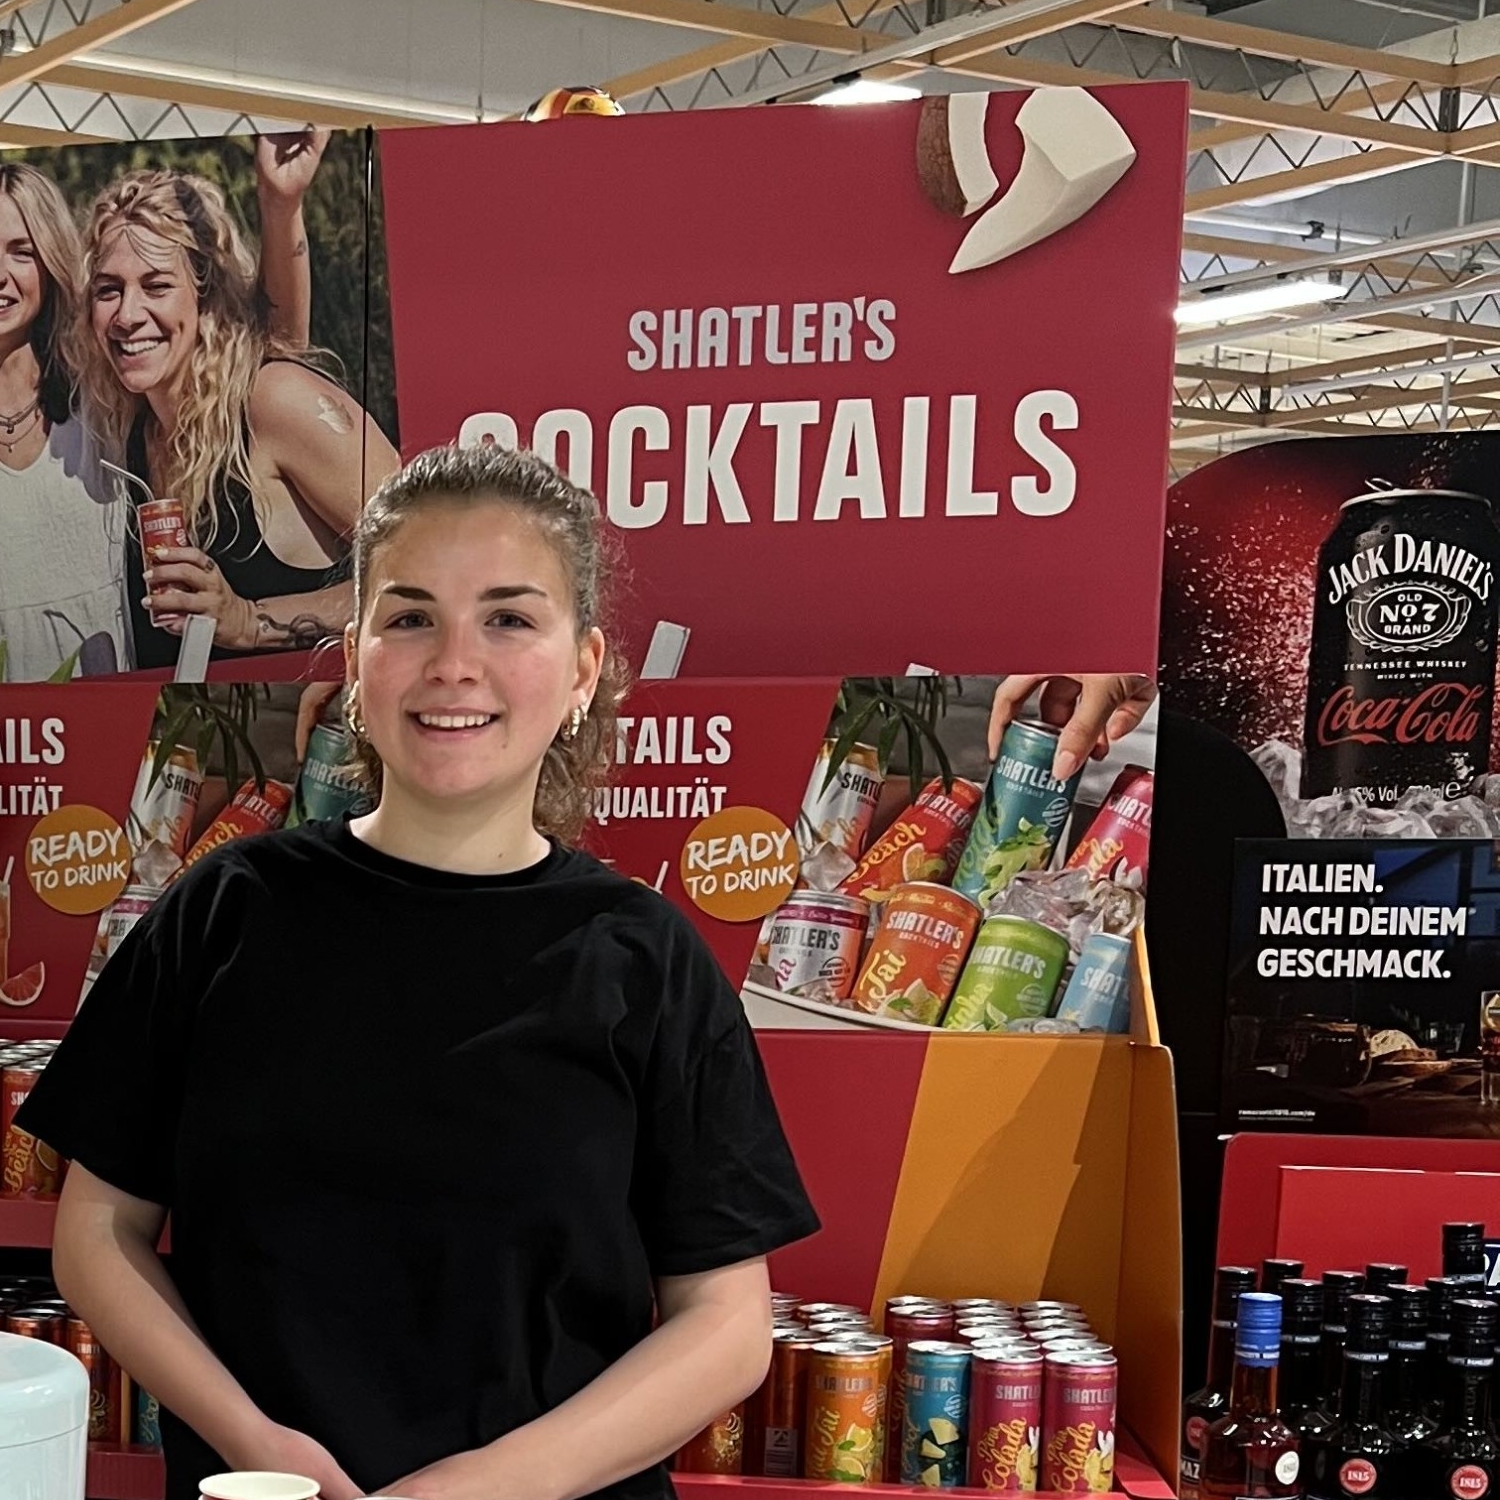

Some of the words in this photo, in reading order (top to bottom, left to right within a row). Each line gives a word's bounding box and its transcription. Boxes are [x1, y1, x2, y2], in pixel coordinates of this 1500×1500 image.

[627, 296, 897, 372] SHATLER'S
[1328, 543, 1389, 605] JACK
[1395, 533, 1494, 601] DANIEL'S
[1398, 593, 1423, 602] OLD
[1421, 603, 1441, 622] 7
[1384, 624, 1431, 635] BRAND
[30, 827, 122, 866] READY
[687, 829, 792, 871] READY
[31, 869, 59, 893] TO
[64, 859, 128, 890] DRINK
[686, 876, 718, 899] TO
[723, 863, 796, 893] DRINK
[1262, 864, 1384, 893] ITALIEN.
[1259, 906, 1344, 935] NACH
[1349, 906, 1467, 936] DEINEM
[1257, 949, 1452, 978] GESCHMACK.
